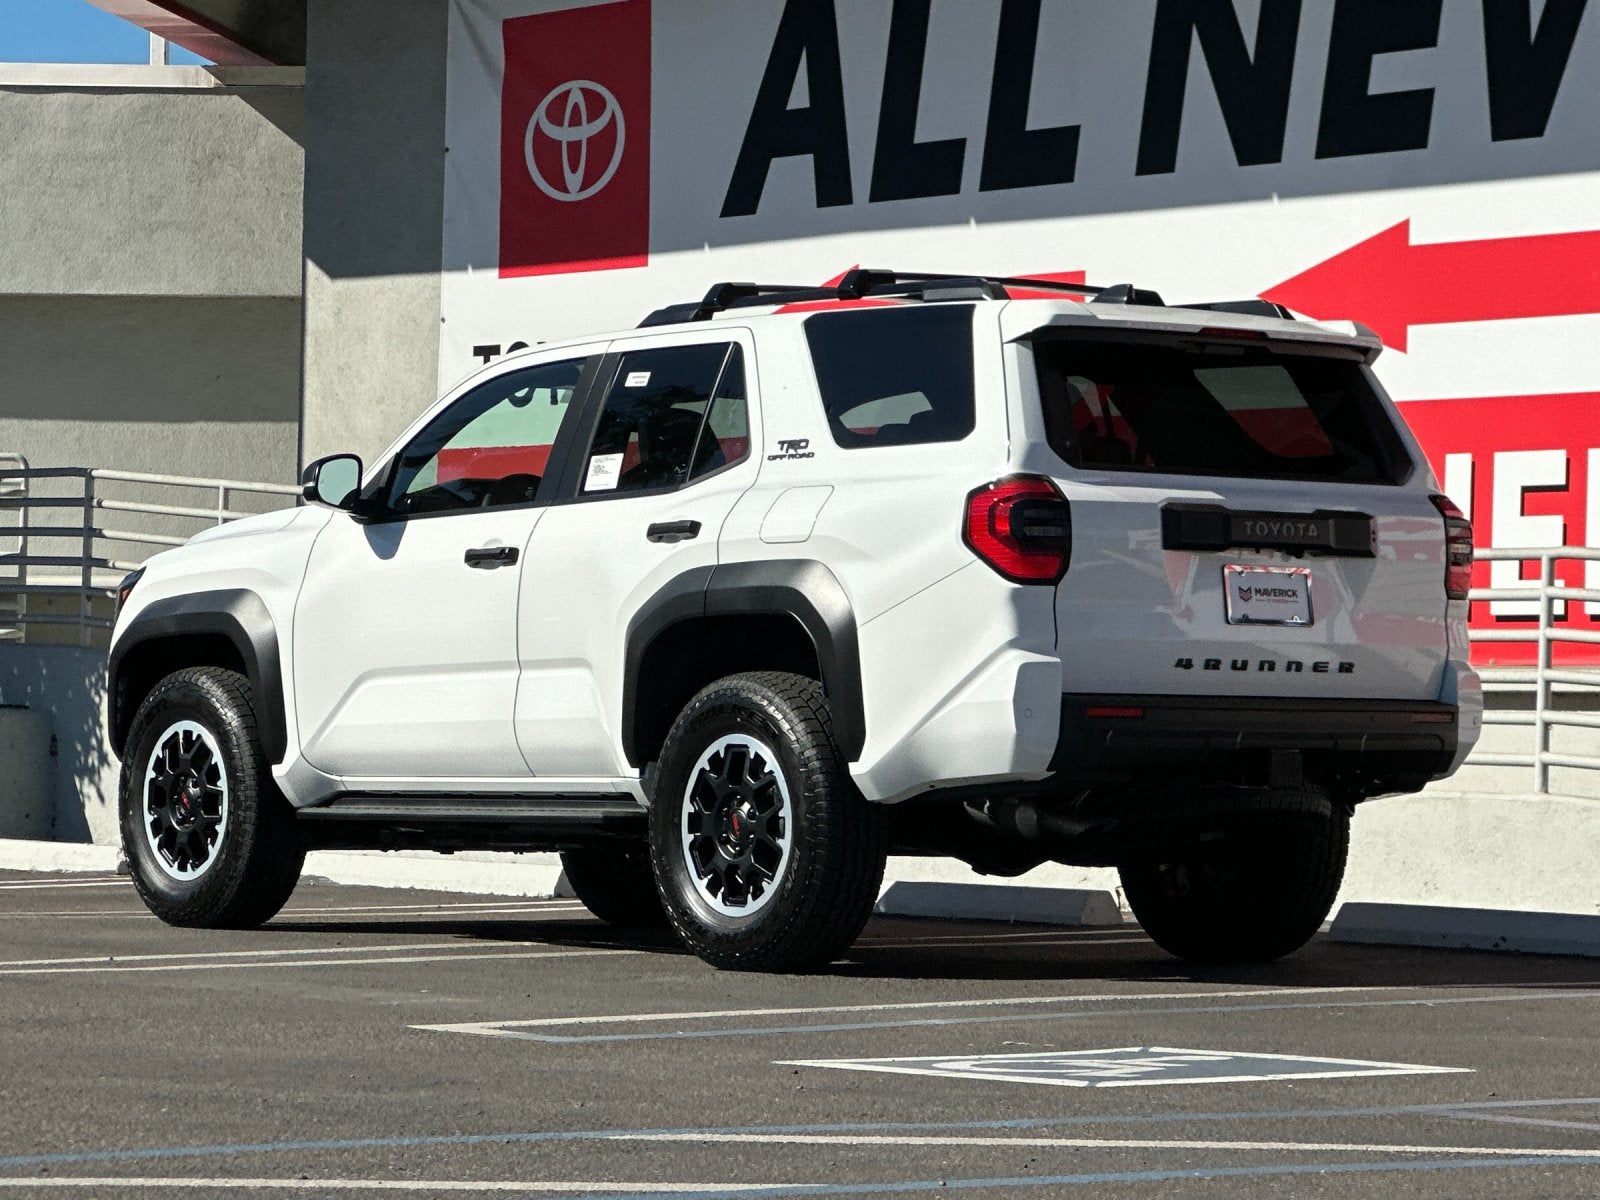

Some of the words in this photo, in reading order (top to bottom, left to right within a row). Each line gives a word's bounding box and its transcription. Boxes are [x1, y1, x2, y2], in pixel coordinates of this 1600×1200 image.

[719, 0, 1081, 218] ALL
[777, 438, 809, 454] TRD
[1243, 521, 1319, 537] TOYOTA
[1254, 587, 1298, 599] MAVERICK
[1174, 657, 1356, 674] 4RUNNER
